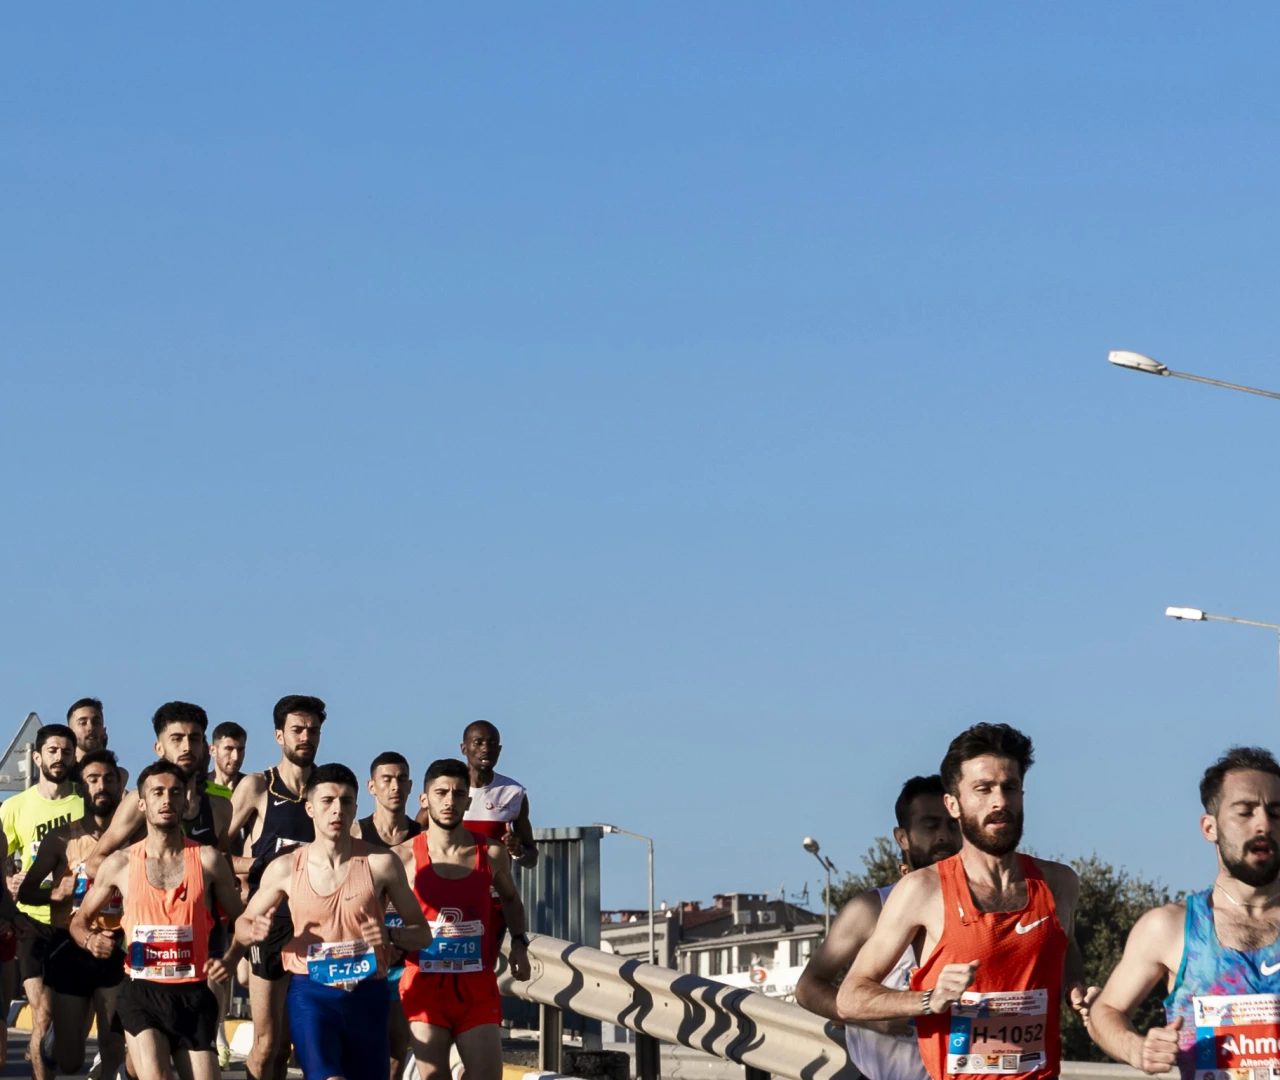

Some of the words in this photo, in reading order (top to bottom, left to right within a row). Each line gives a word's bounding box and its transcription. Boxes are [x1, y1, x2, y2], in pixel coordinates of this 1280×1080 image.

[36, 812, 72, 842] RUN
[438, 941, 476, 955] F-719
[328, 959, 371, 978] F-759
[972, 1023, 1044, 1045] H-1052
